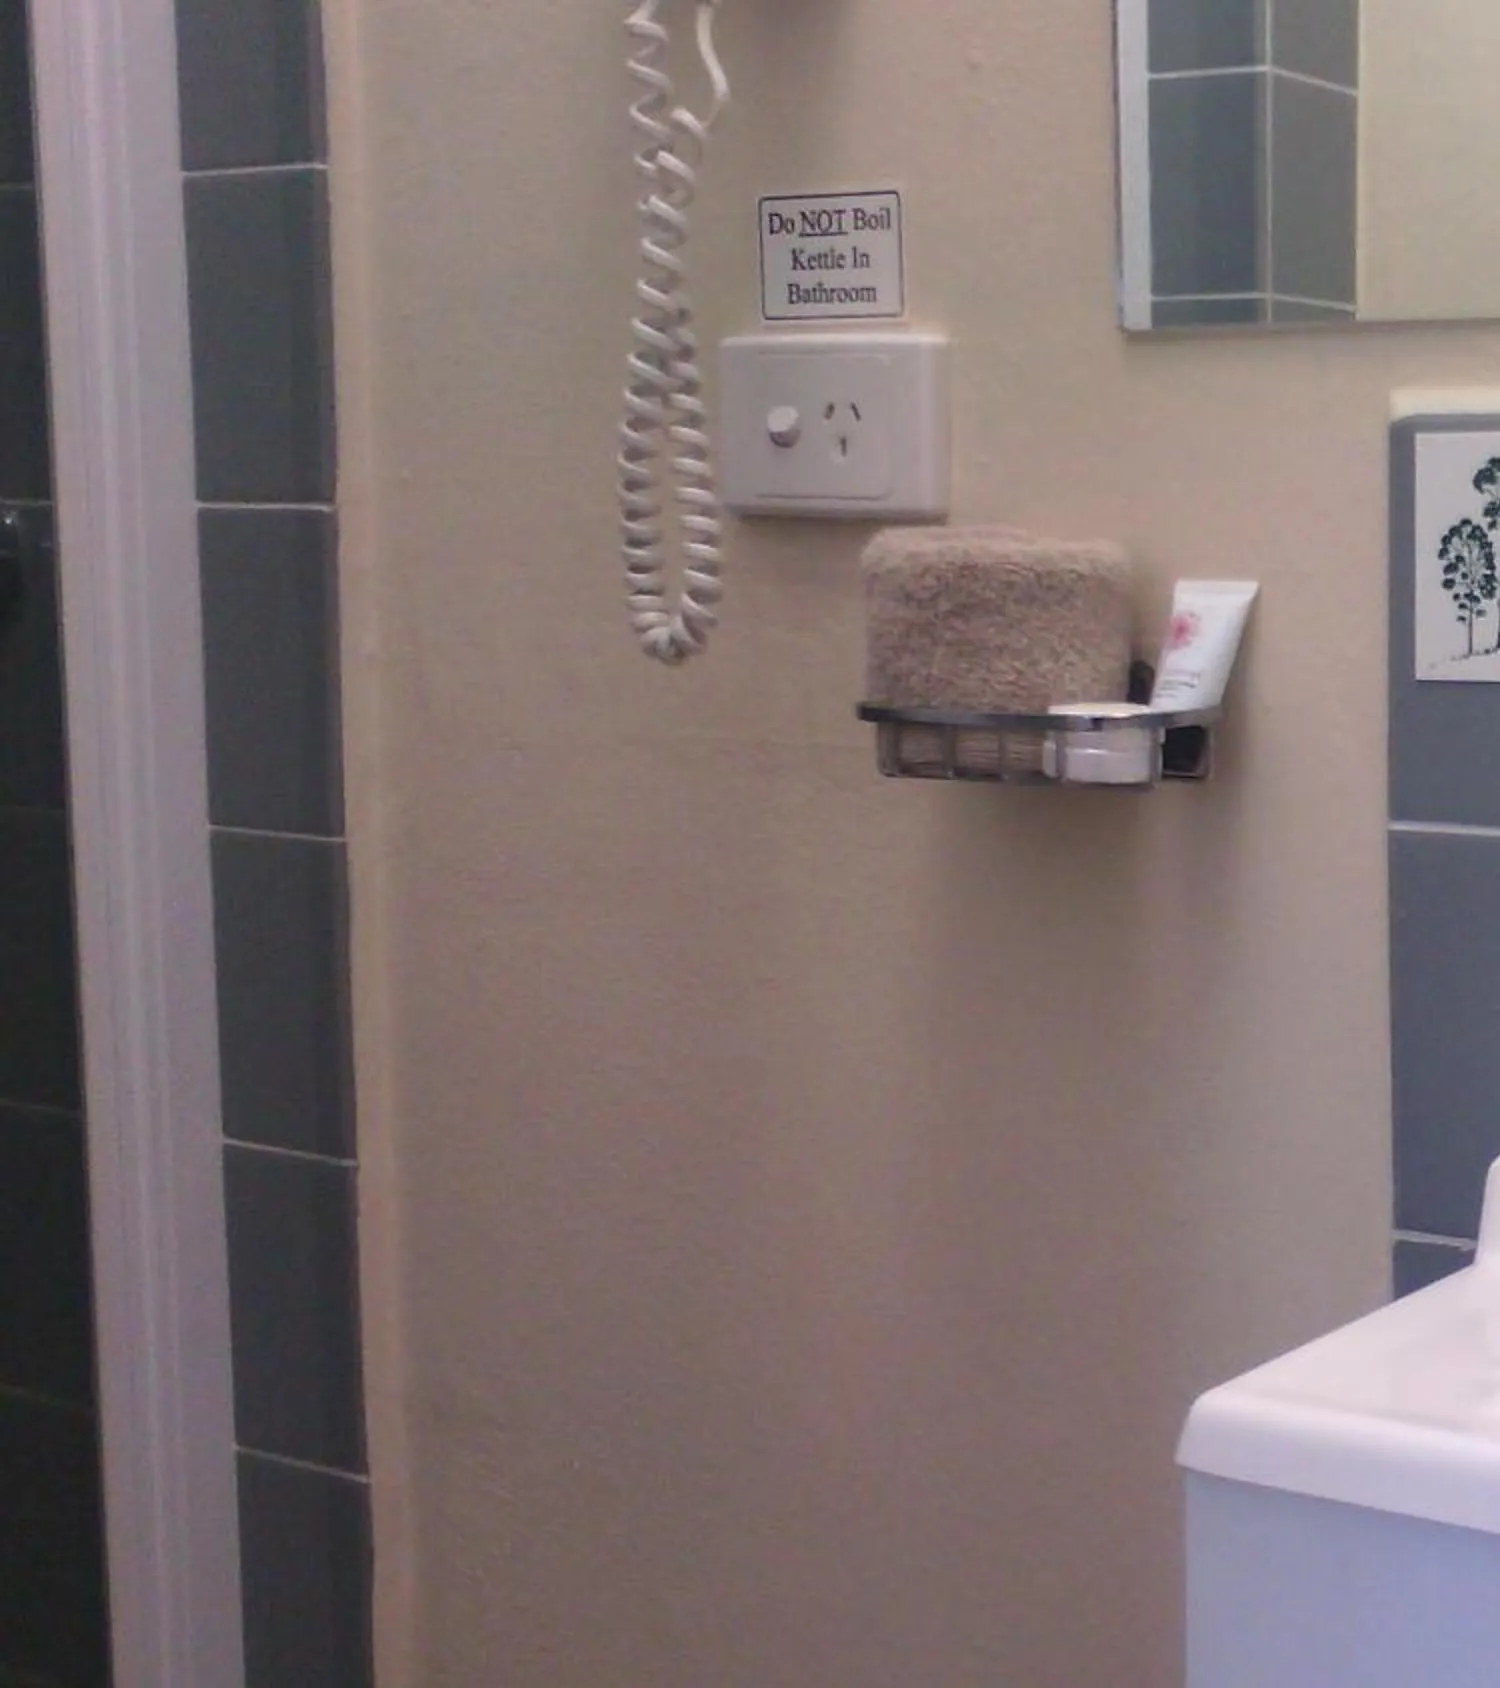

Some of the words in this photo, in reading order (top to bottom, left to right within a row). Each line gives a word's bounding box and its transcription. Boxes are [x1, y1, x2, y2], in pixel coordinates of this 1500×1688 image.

[768, 212, 795, 235] Do
[799, 208, 848, 237] NOT
[852, 206, 891, 231] Boil
[790, 246, 846, 271] Kettle
[851, 245, 870, 269] In
[786, 280, 877, 305] Bathroom
